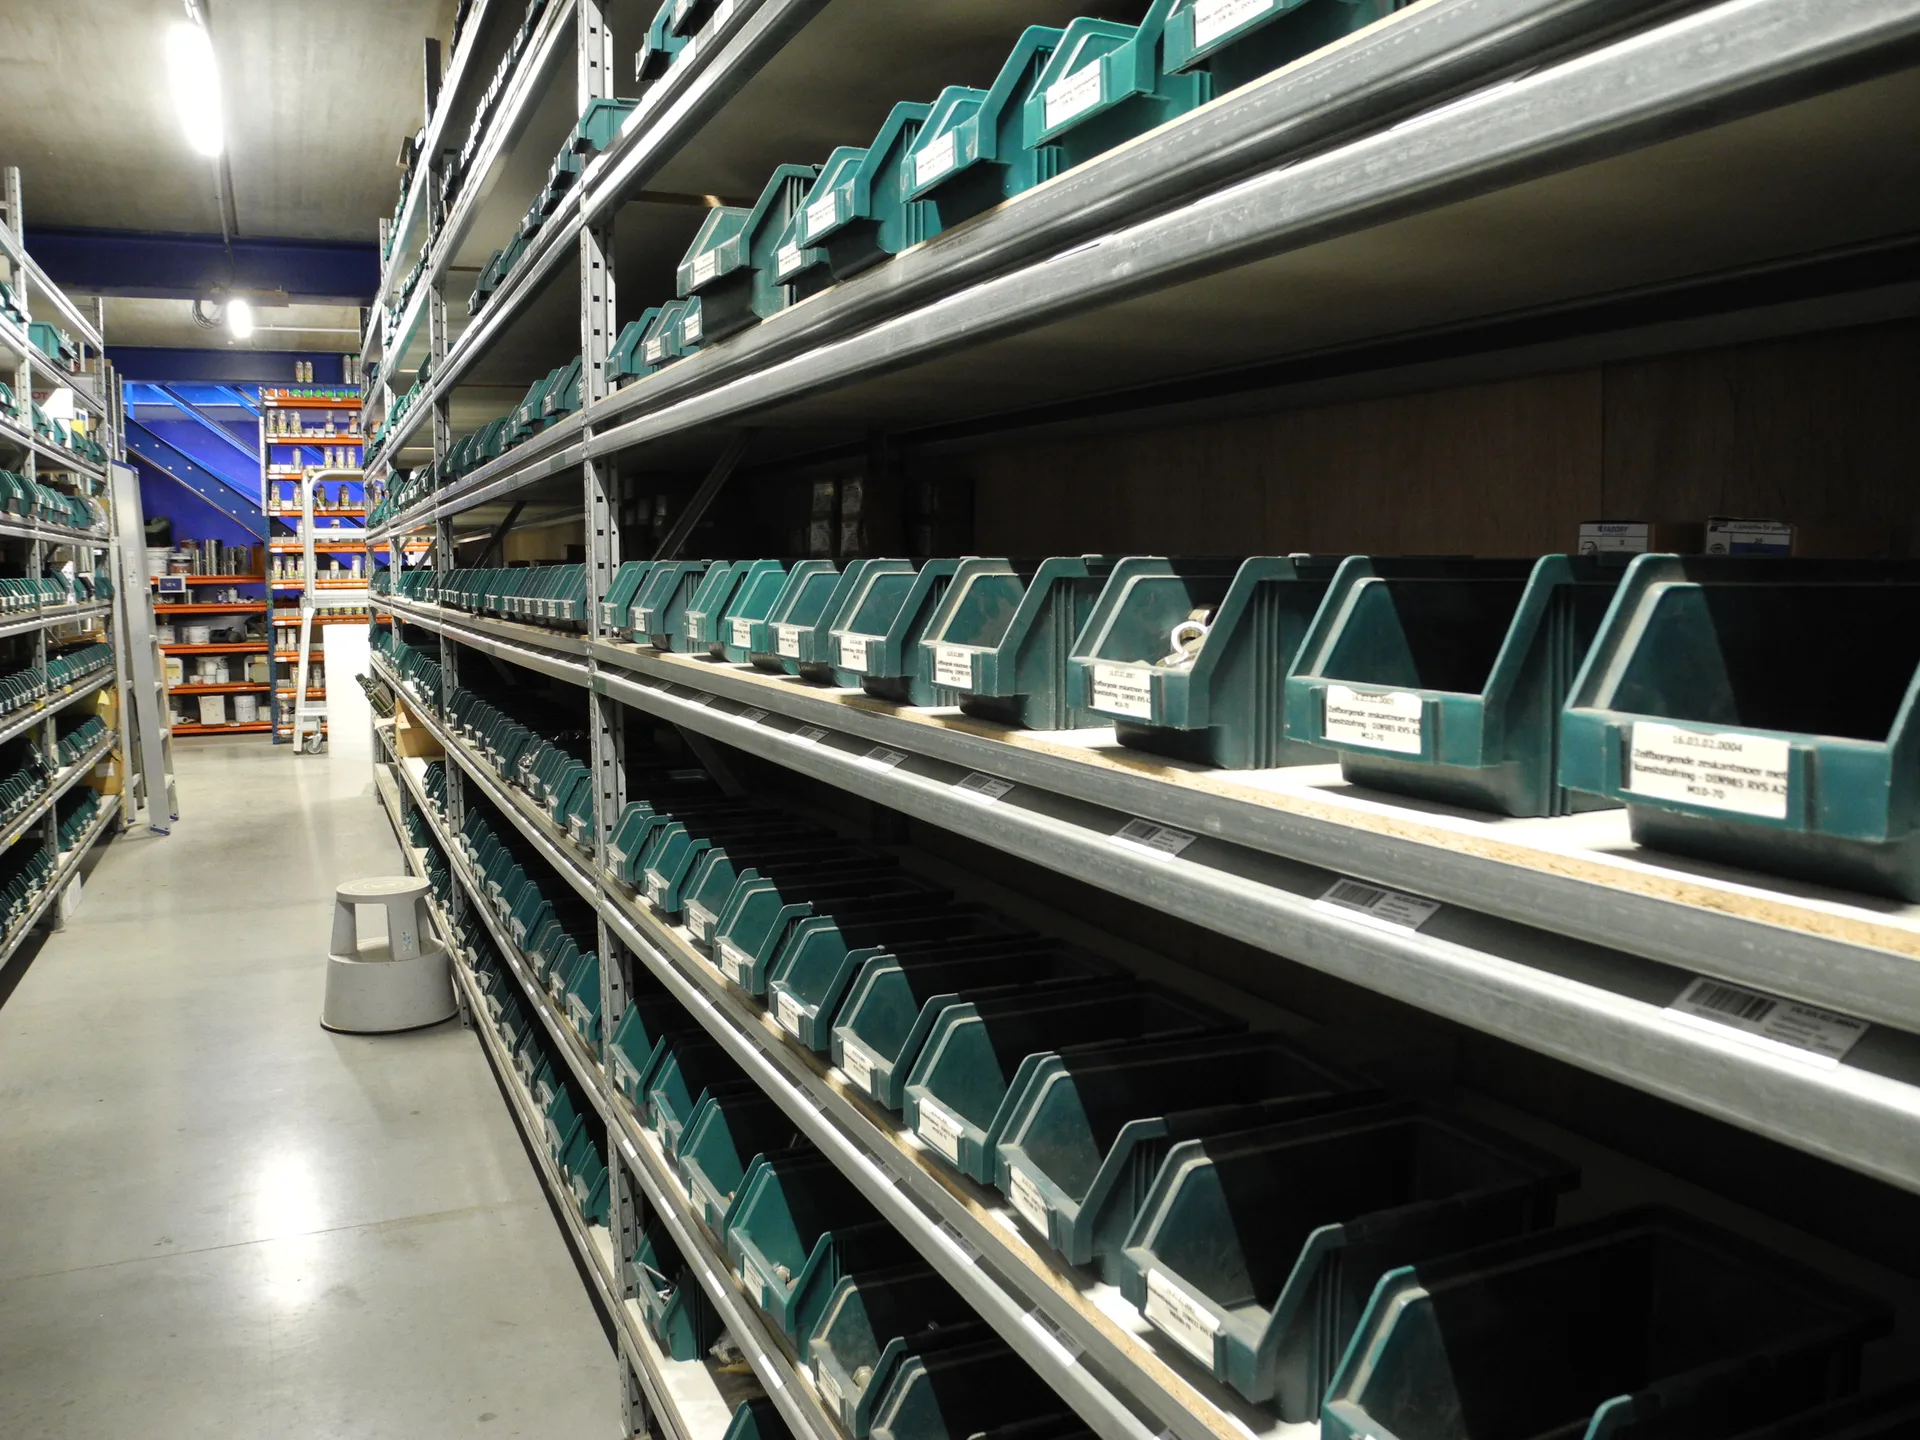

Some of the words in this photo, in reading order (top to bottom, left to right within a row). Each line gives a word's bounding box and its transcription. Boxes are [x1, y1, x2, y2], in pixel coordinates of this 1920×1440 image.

[1672, 735, 1743, 752] 16.03.02.0004
[1634, 747, 1694, 765] Zelfborgende
[1697, 760, 1762, 776] zeskantmoer
[1687, 785, 1725, 799] M10-70
[1705, 773, 1744, 789] DIN985
[1747, 780, 1768, 793] RVS
